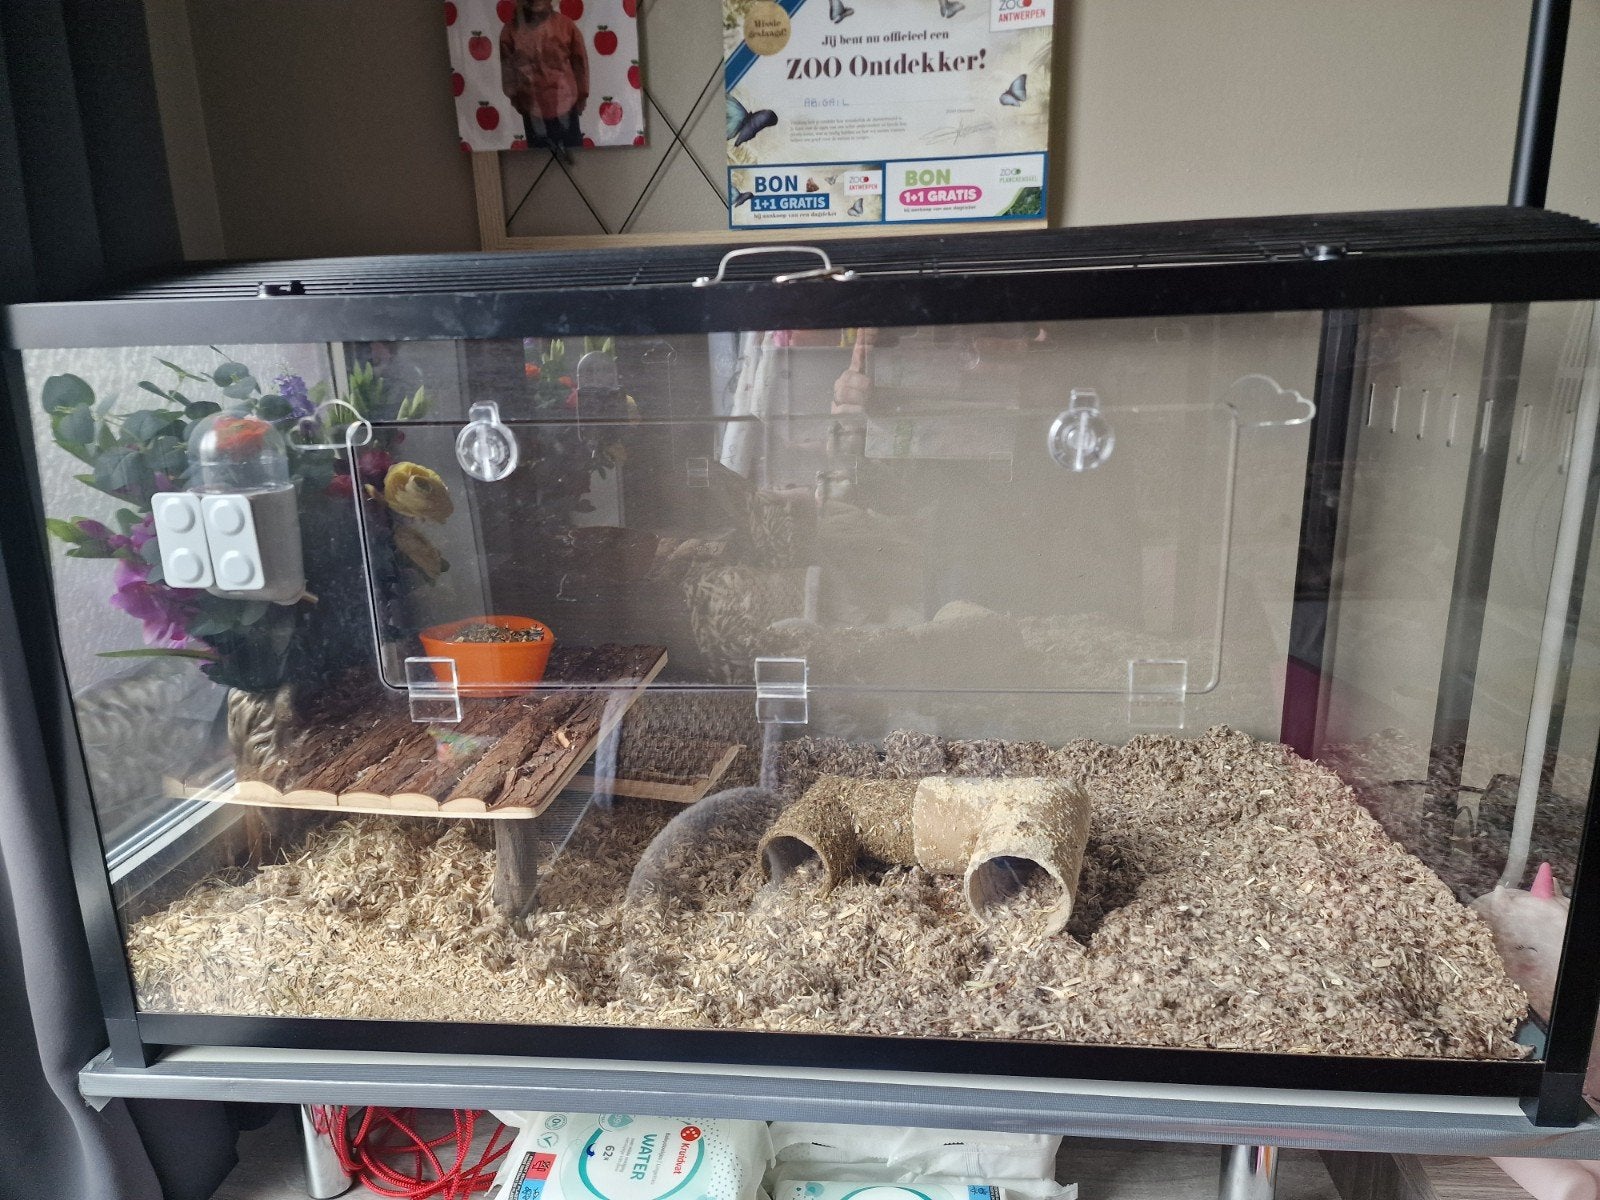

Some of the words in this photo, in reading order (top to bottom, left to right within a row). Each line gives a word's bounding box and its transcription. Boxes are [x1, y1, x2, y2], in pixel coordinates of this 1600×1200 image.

[754, 19, 781, 28] Missie
[998, 9, 1046, 23] ANTWERPEN
[821, 35, 836, 47] Jij
[840, 34, 863, 44] bent
[883, 30, 927, 42] officieel
[930, 31, 949, 40] een
[786, 56, 842, 80] ZOO
[849, 48, 986, 77] Ontdekker!
[755, 175, 798, 193] BON
[905, 168, 950, 186] BON
[754, 198, 777, 210] 1+1
[780, 196, 826, 209] GRATIS
[904, 191, 924, 203] 1+1
[927, 188, 977, 202] GRATIS
[630, 1133, 657, 1180] WATER
[673, 1142, 691, 1175] Kruidvat
